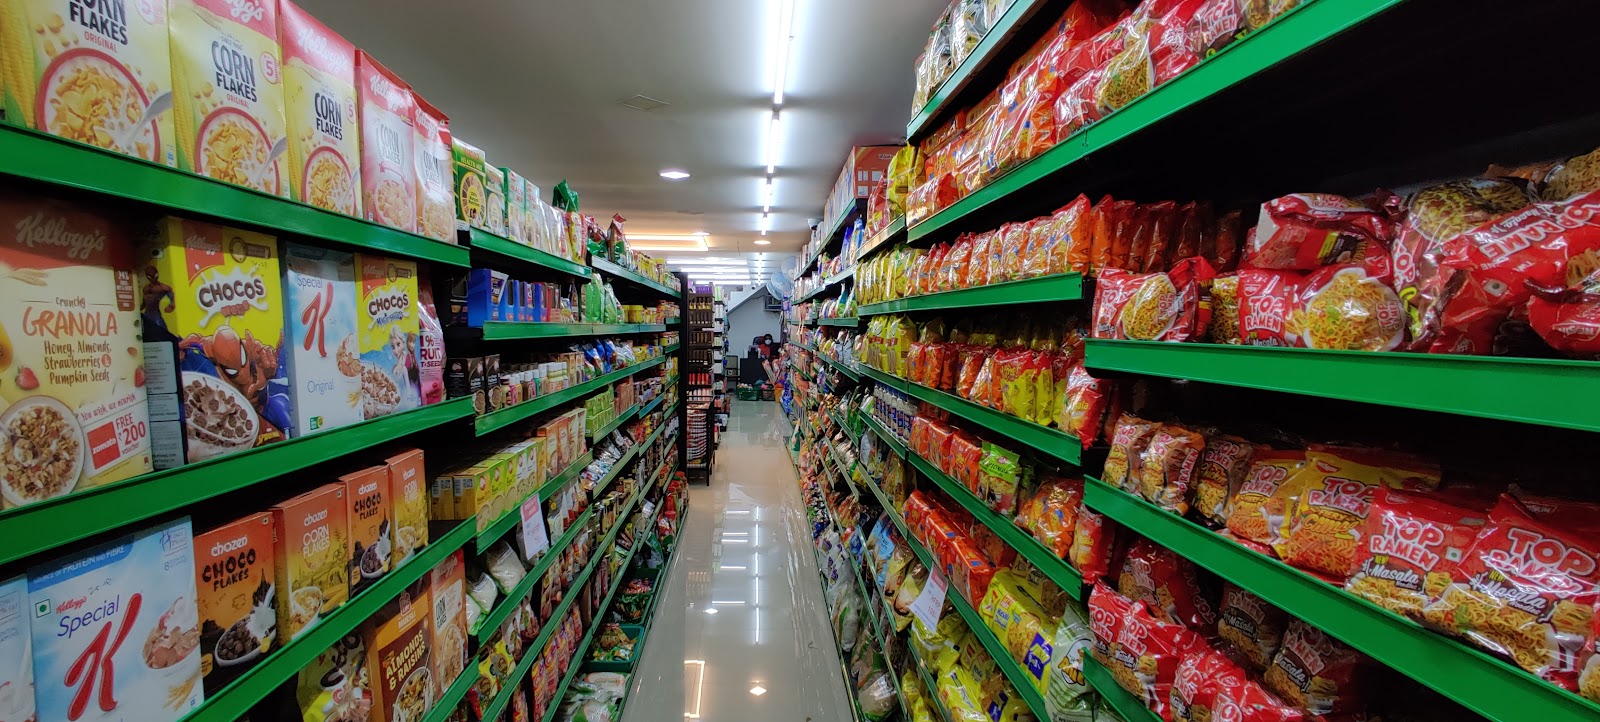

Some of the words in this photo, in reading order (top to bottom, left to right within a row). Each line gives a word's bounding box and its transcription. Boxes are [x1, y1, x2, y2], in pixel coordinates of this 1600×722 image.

[69, 1, 128, 45] FLAKES
[84, 31, 118, 53] ORIGINAL
[298, 27, 348, 73] Kellogg's
[211, 40, 256, 87] CORN
[265, 60, 274, 77] 5
[216, 71, 257, 103] FLAKES
[226, 93, 250, 109] ORIGINAL
[314, 92, 343, 128] CORN
[348, 104, 354, 117] 5
[316, 118, 343, 141] FLAKES
[16, 213, 105, 260] Kellogg's
[296, 273, 323, 289] Special
[199, 278, 264, 308] CHOCOS
[368, 294, 409, 316] CHOCOS
[1249, 295, 1285, 316] TOP
[1377, 301, 1390, 329] TOP
[22, 306, 118, 339] GRANOLA
[301, 281, 333, 357] K
[1245, 313, 1281, 333] RAMEN
[44, 356, 101, 370] Strawberries
[420, 347, 441, 360] RUIT
[49, 371, 89, 386] Pumpkin
[90, 370, 110, 383] Seeds
[307, 379, 334, 395] Original
[115, 412, 134, 430] FREE
[92, 437, 117, 454] zomato
[121, 441, 140, 455] voucher
[1179, 447, 1199, 482] RAMEN
[1250, 465, 1288, 482] TOP
[1240, 481, 1279, 498] RAMEN
[354, 492, 381, 514] CHOCO
[1309, 490, 1370, 518] RAMEN
[303, 523, 329, 547] CORN
[1383, 515, 1444, 547] TOP
[211, 536, 248, 557] chozen
[303, 538, 330, 558] FLAKES
[1369, 533, 1440, 572] RAMEN
[1506, 527, 1598, 577] TOP
[202, 549, 256, 583] CHOCO
[1371, 564, 1419, 584] Masala
[1484, 549, 1584, 599] RAMEN
[213, 568, 249, 592] FLAKES
[55, 595, 87, 614] Kellogg's
[1484, 581, 1548, 609] Masala
[57, 594, 120, 639] Special
[1087, 604, 1116, 627] TOP
[1228, 617, 1255, 634] Masala
[64, 593, 142, 721] K
[386, 630, 424, 680] ALMONDS
[389, 678, 397, 691] &
[397, 640, 426, 681] RAISINS
